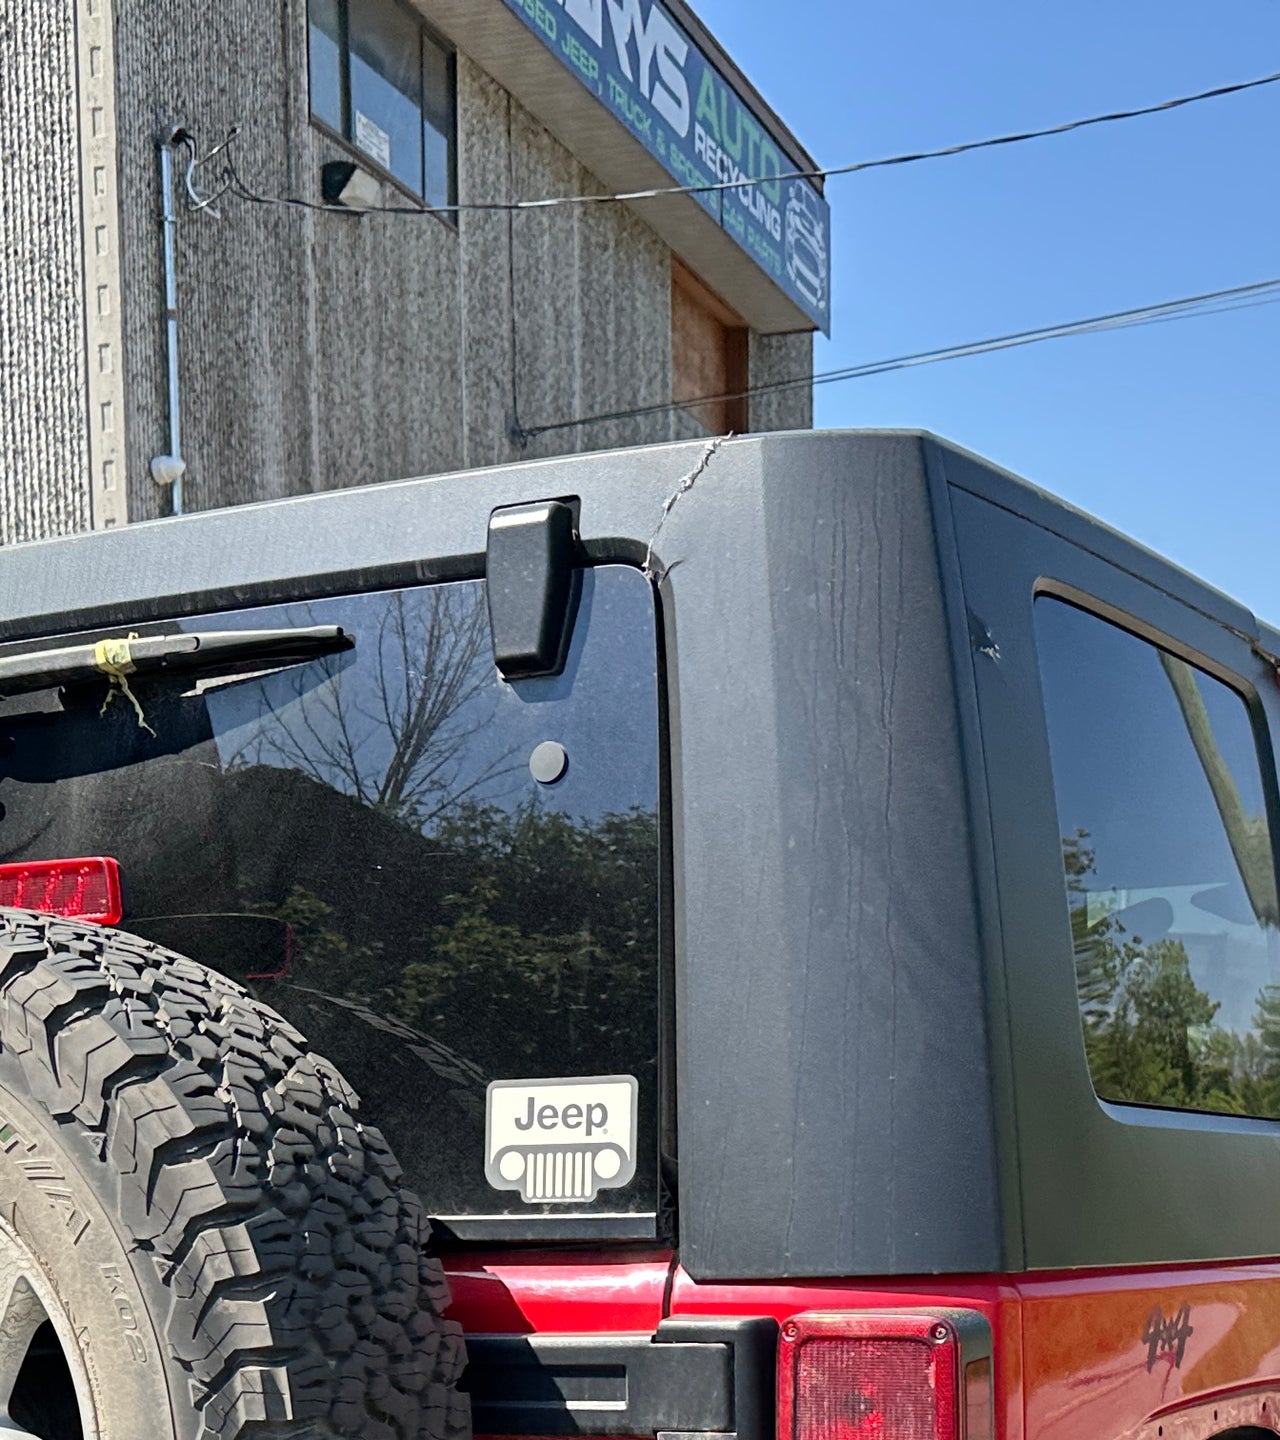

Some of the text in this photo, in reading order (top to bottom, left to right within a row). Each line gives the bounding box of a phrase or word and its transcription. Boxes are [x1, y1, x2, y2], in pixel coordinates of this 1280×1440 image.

[556, 0, 689, 138] RYS
[695, 66, 781, 206] AUTO
[517, 0, 557, 41] SED
[561, 32, 603, 95] JEEP,
[606, 73, 653, 140] TRUCK
[722, 198, 745, 234] CAR
[747, 224, 782, 277] PARTS
[694, 120, 782, 243] RECYCLING
[513, 1096, 609, 1137] Jeep
